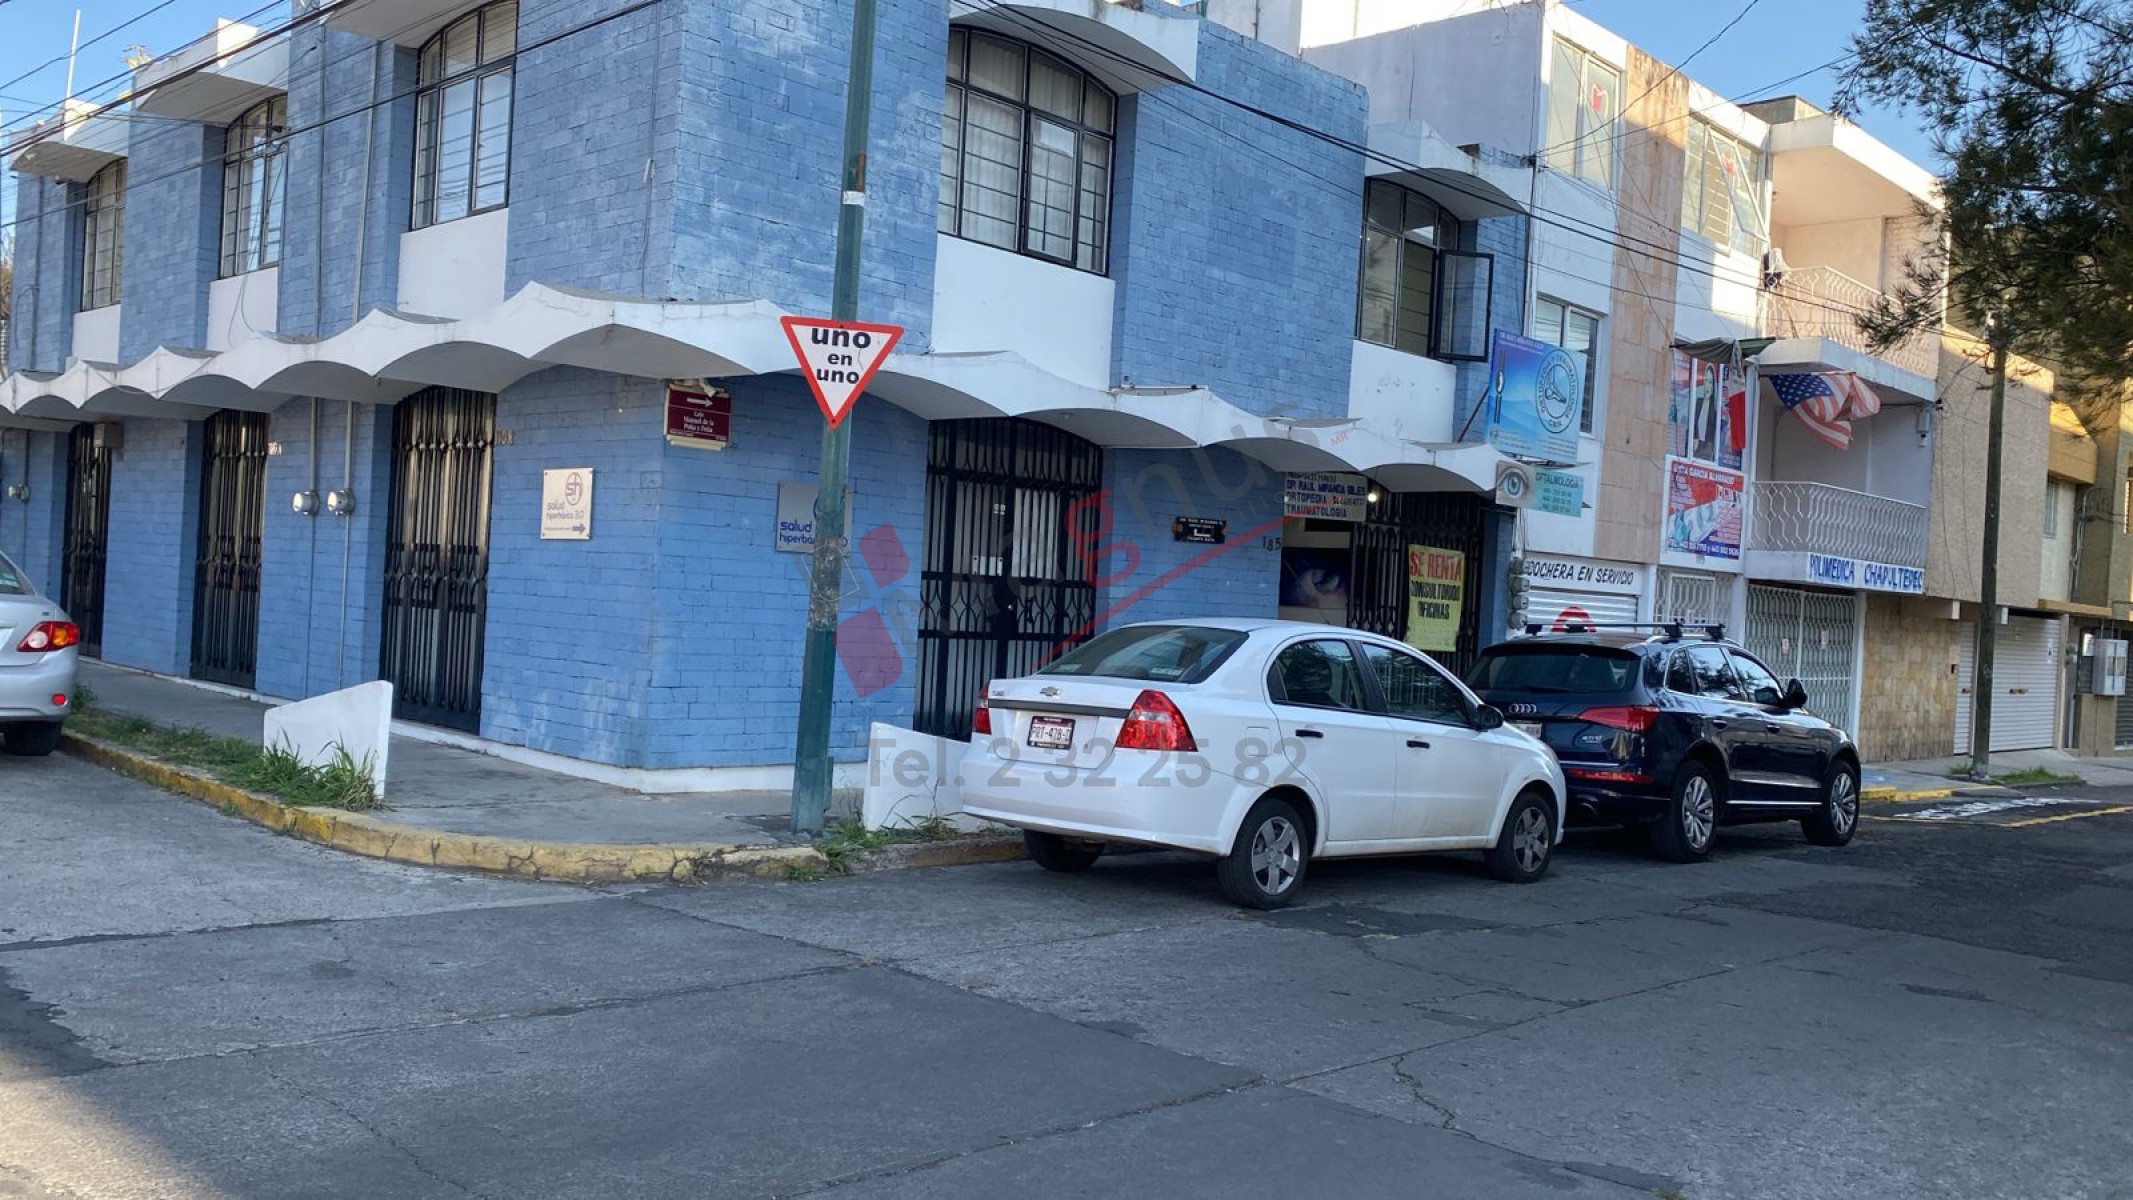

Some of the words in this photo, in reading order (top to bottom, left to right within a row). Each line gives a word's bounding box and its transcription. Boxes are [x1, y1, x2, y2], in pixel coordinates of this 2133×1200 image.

[811, 327, 871, 348] uno
[827, 353, 852, 366] en
[816, 368, 859, 384] uno
[780, 518, 812, 532] salud
[1262, 536, 1280, 551] 185
[1410, 551, 1424, 576] SE
[1427, 553, 1461, 581] RENTA
[1527, 561, 1574, 579] COCHERA
[1578, 566, 1593, 581] EN
[1596, 568, 1634, 585] SERVICIO
